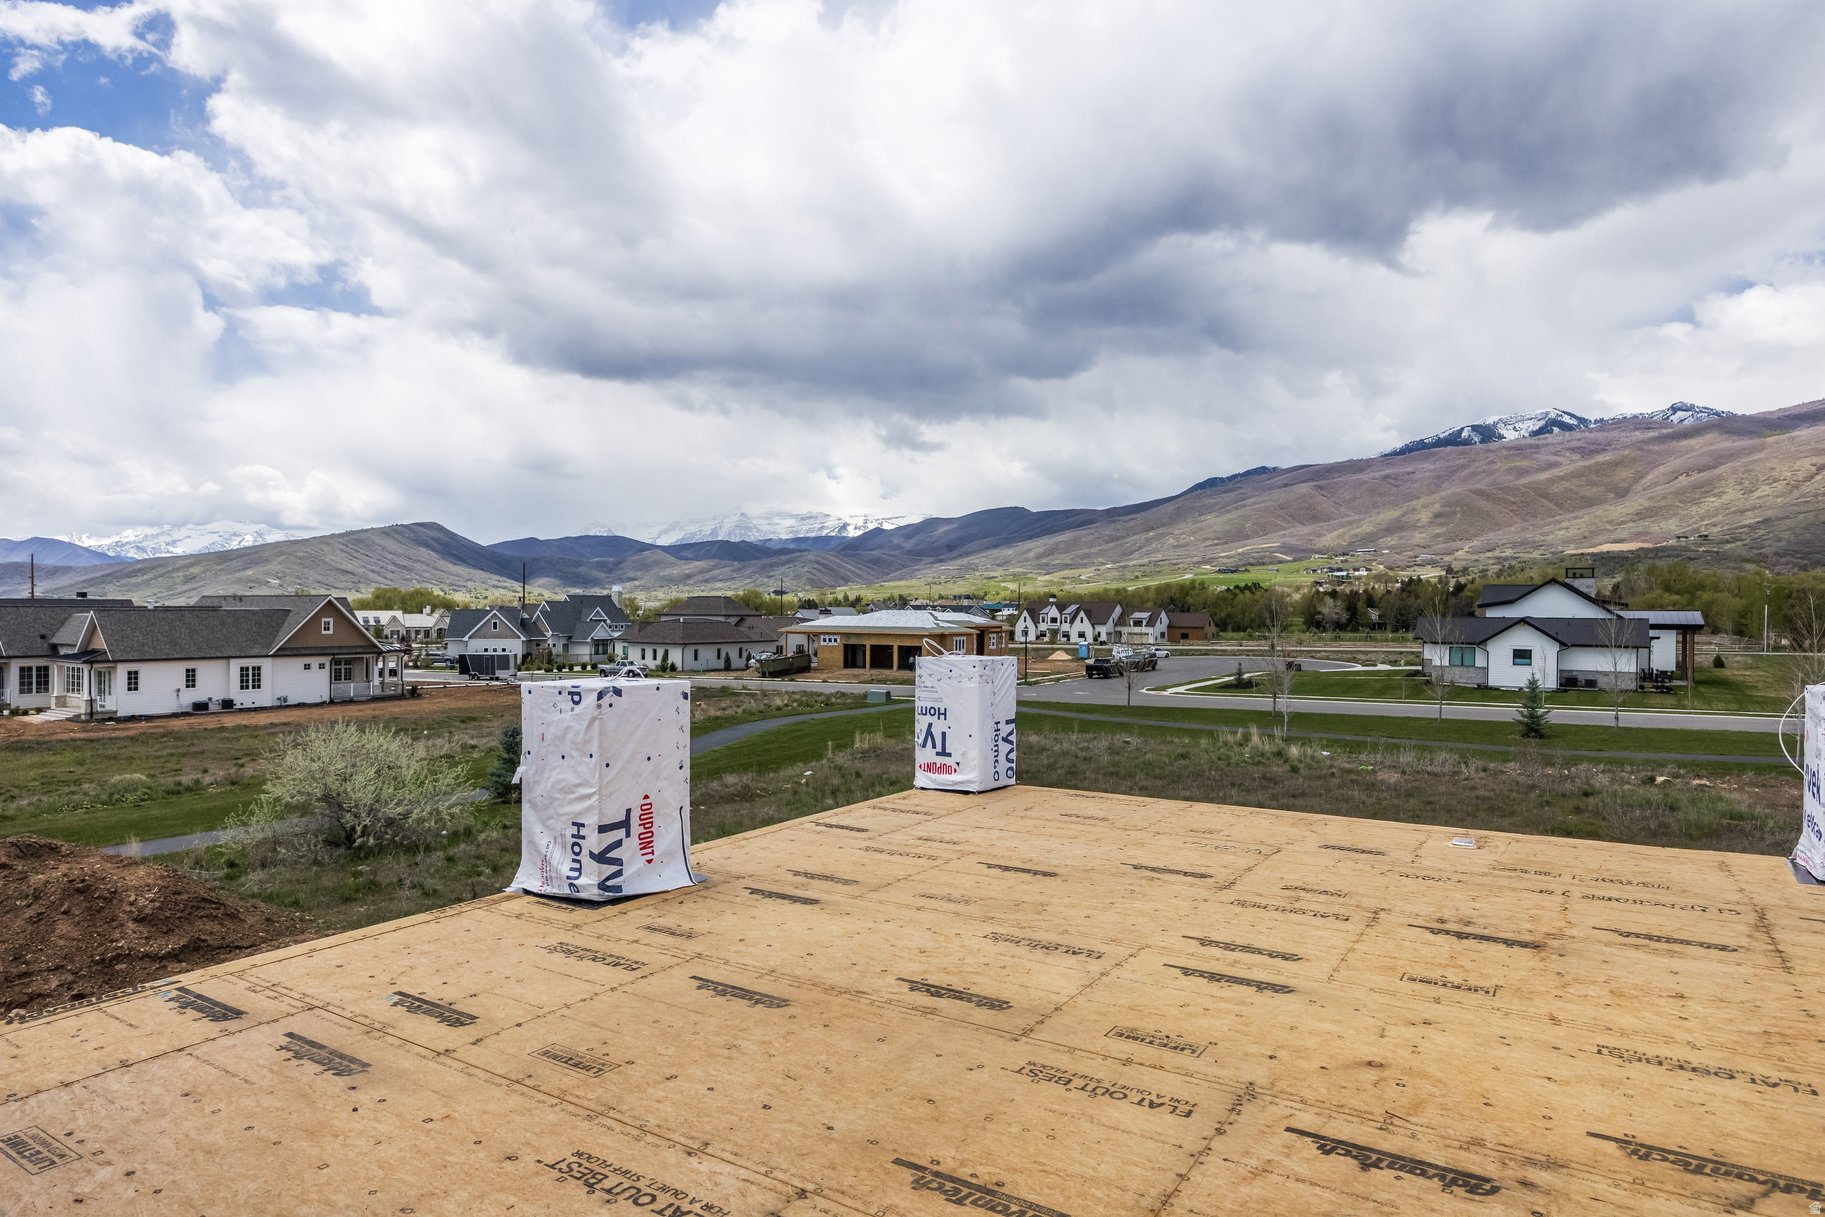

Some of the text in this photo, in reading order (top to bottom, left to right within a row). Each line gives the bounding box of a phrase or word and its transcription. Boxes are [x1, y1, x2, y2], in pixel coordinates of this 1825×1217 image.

[923, 762, 952, 775] DUPONT
[638, 802, 655, 857] DUPONT
[566, 821, 586, 894] Home
[1112, 1031, 1198, 1055] LIFETIME
[537, 1049, 605, 1075] LIFETIME
[1010, 1066, 1194, 1119] FLAT OUT BEST
[1743, 1077, 1820, 1097] FLAT
[0, 1134, 58, 1170] LIFETIME
[571, 1149, 613, 1169] FLOOR
[544, 1157, 610, 1188] BEST
[609, 1165, 646, 1183] STIFF
[1315, 1142, 1500, 1197] AdvanTech
[600, 1181, 658, 1207] OUT
[689, 1195, 702, 1206] A
[700, 1201, 731, 1217] FOR
